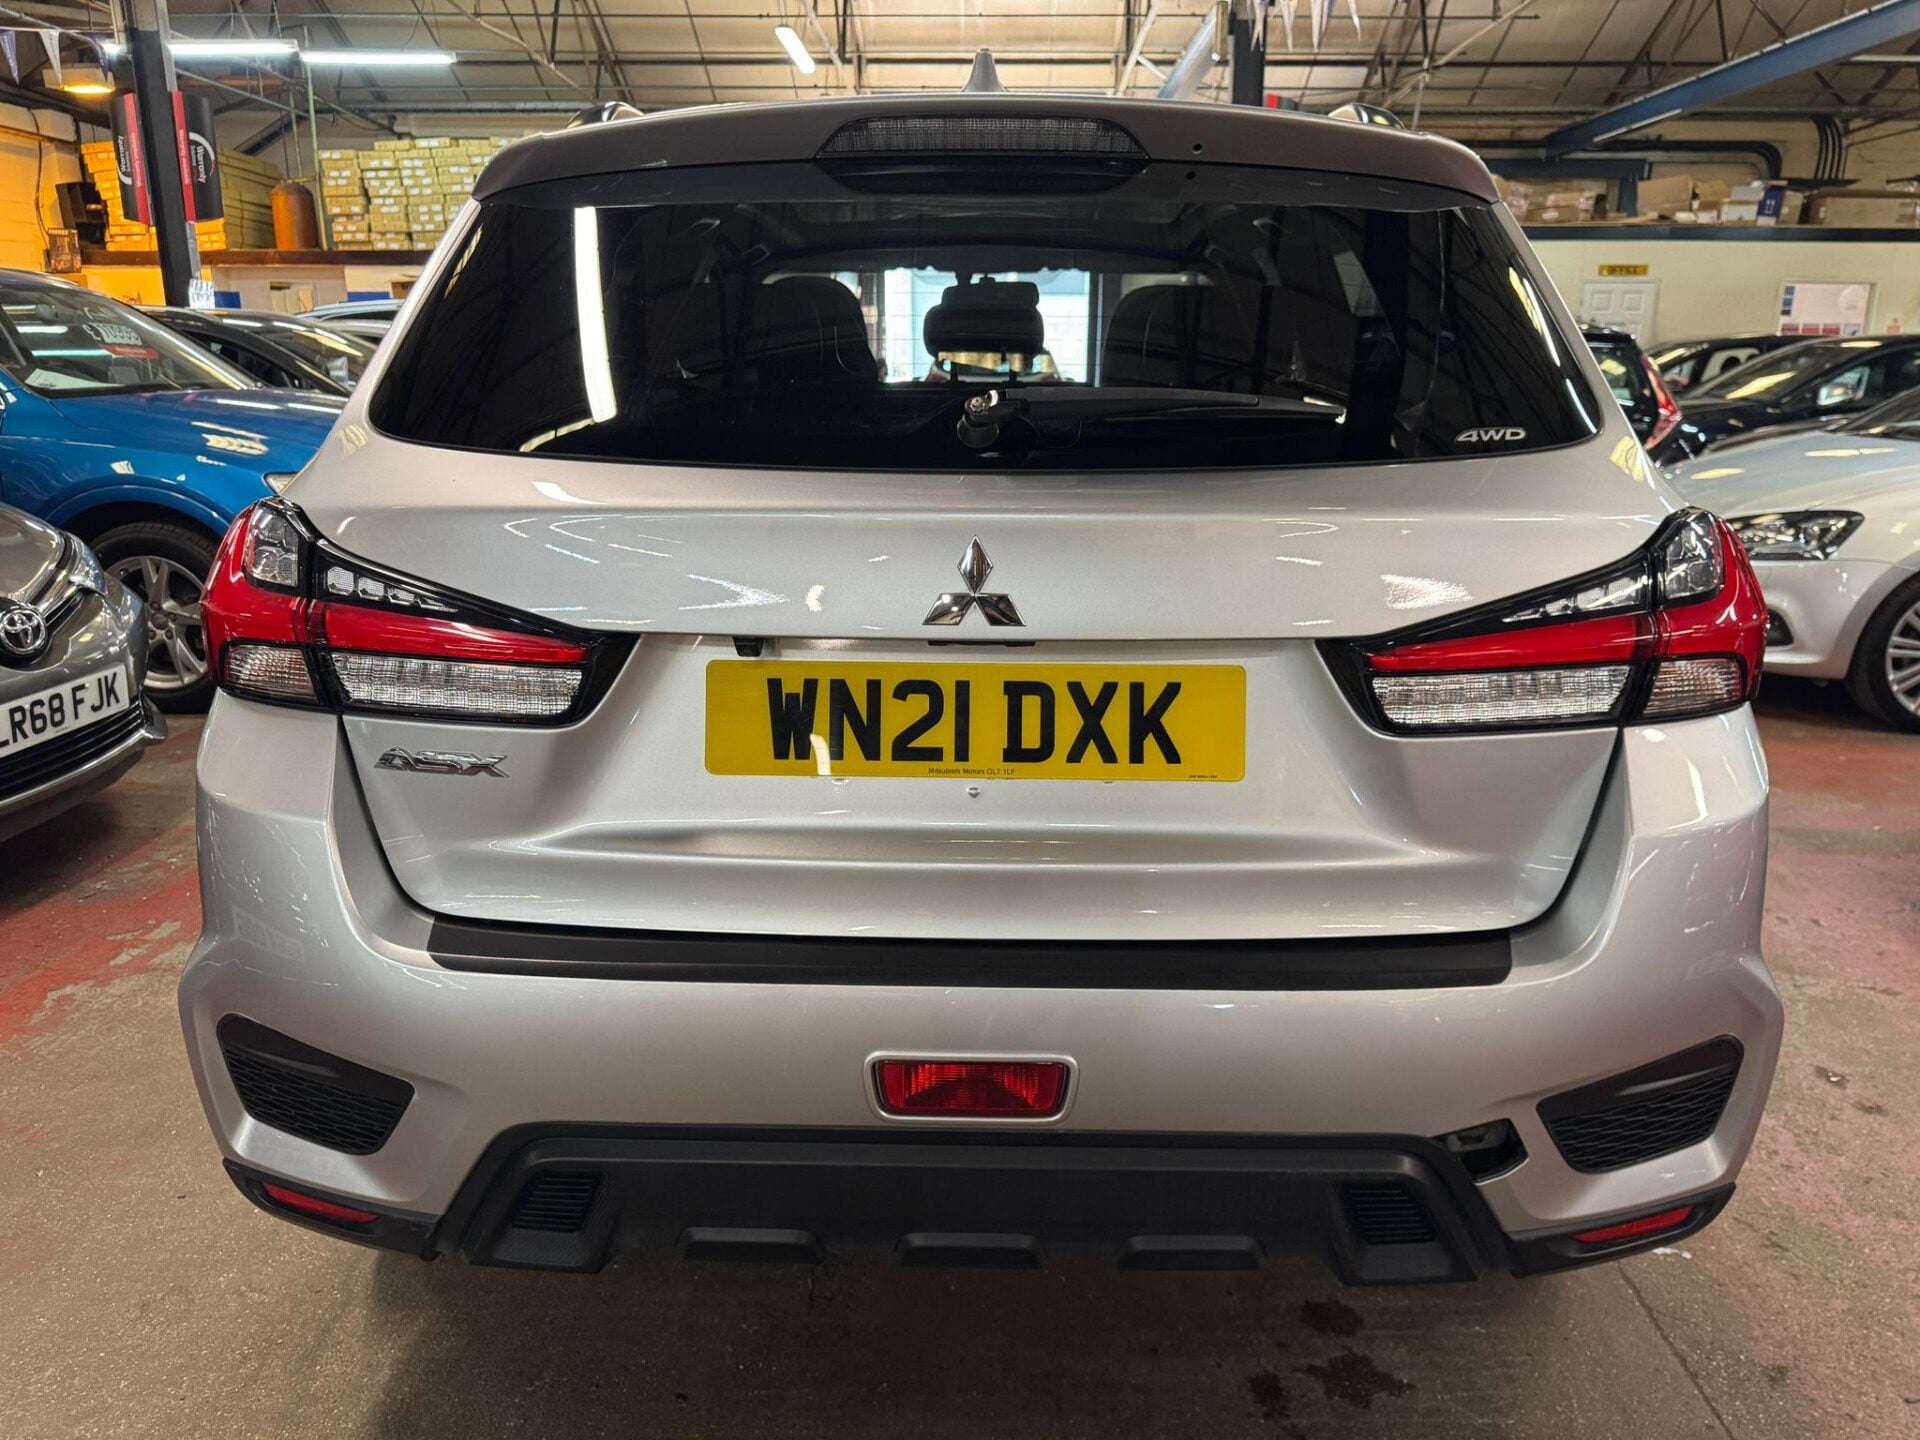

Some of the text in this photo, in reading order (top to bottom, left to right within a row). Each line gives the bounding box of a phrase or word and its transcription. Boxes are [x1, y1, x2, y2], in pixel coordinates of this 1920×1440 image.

[196, 144, 207, 184] Warranty
[1456, 427, 1526, 442] 4WD
[71, 672, 121, 721] FJK
[766, 678, 1182, 764] WN21 DXK
[374, 746, 510, 778] ASX
[928, 767, 961, 775] Mitsubishi
[963, 767, 985, 775] Motors
